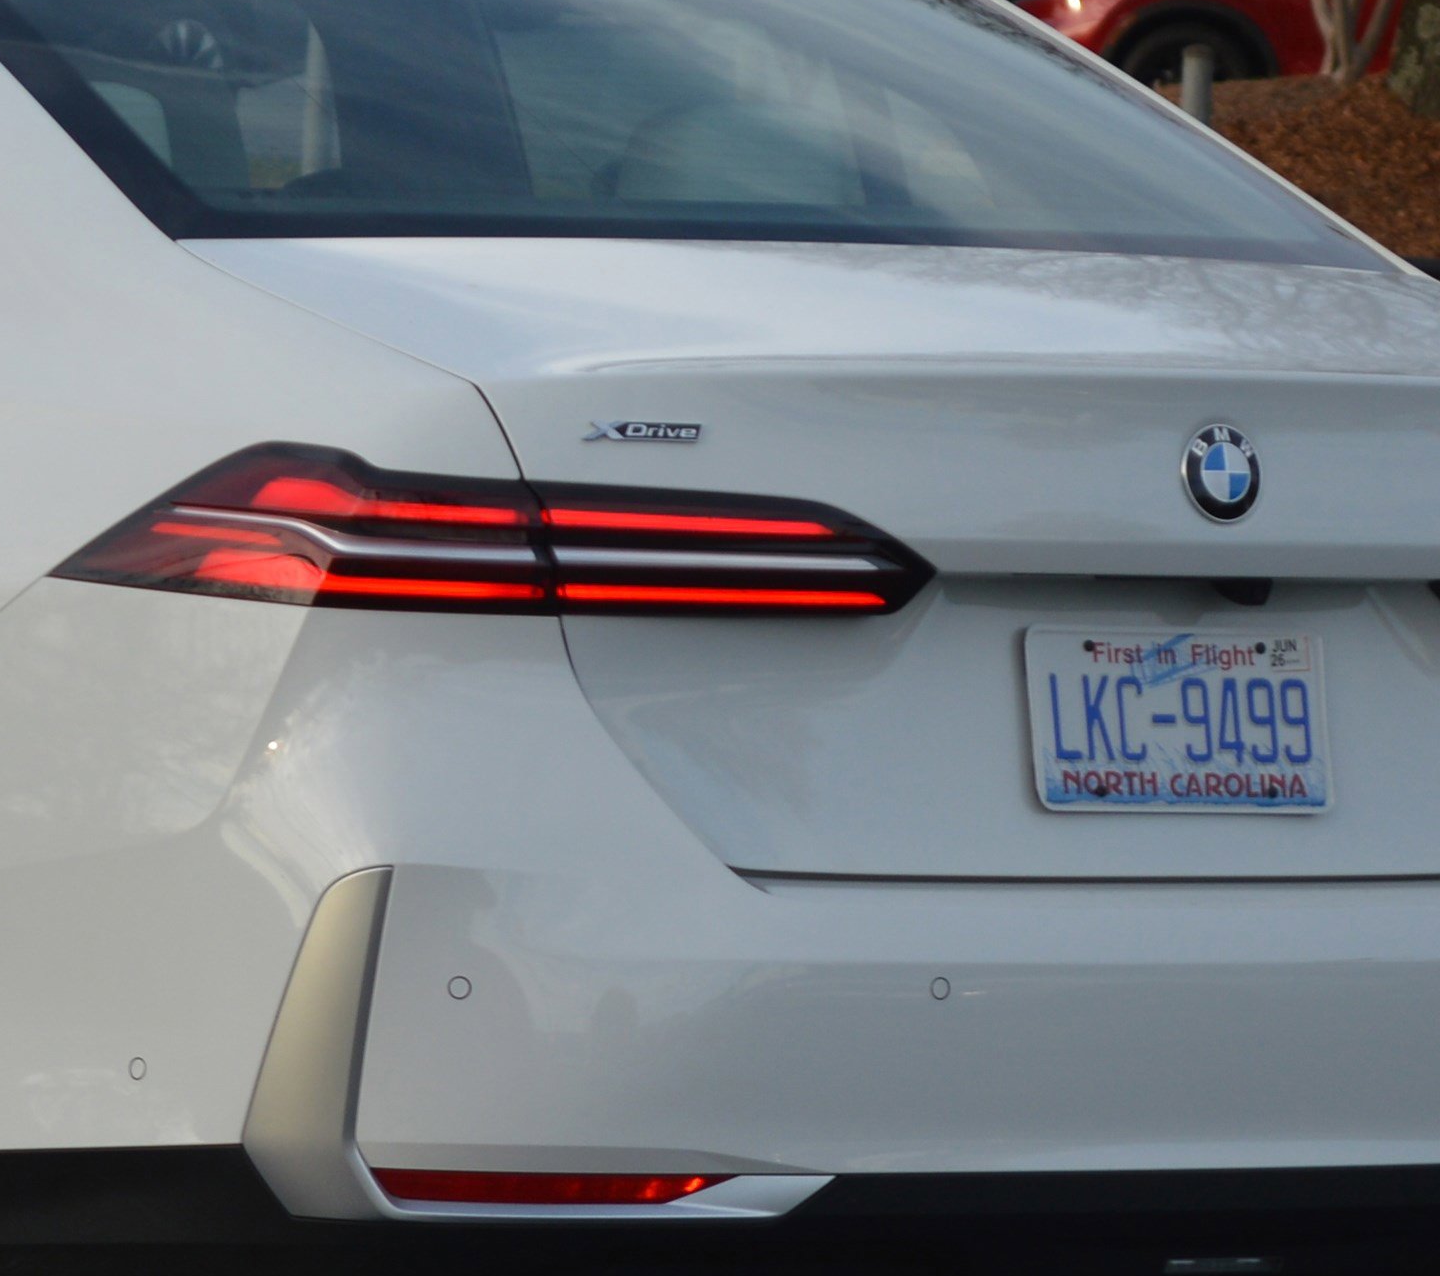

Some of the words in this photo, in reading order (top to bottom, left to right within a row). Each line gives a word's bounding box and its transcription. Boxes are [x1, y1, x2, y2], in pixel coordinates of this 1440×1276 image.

[1092, 642, 1144, 665] First
[1156, 644, 1177, 665] in
[1190, 643, 1255, 670] Flight
[1272, 638, 1298, 653] JUN
[1049, 673, 1313, 764] LKC-9499
[1062, 770, 1159, 797] NORTH
[1170, 773, 1309, 799] CAROLINA
